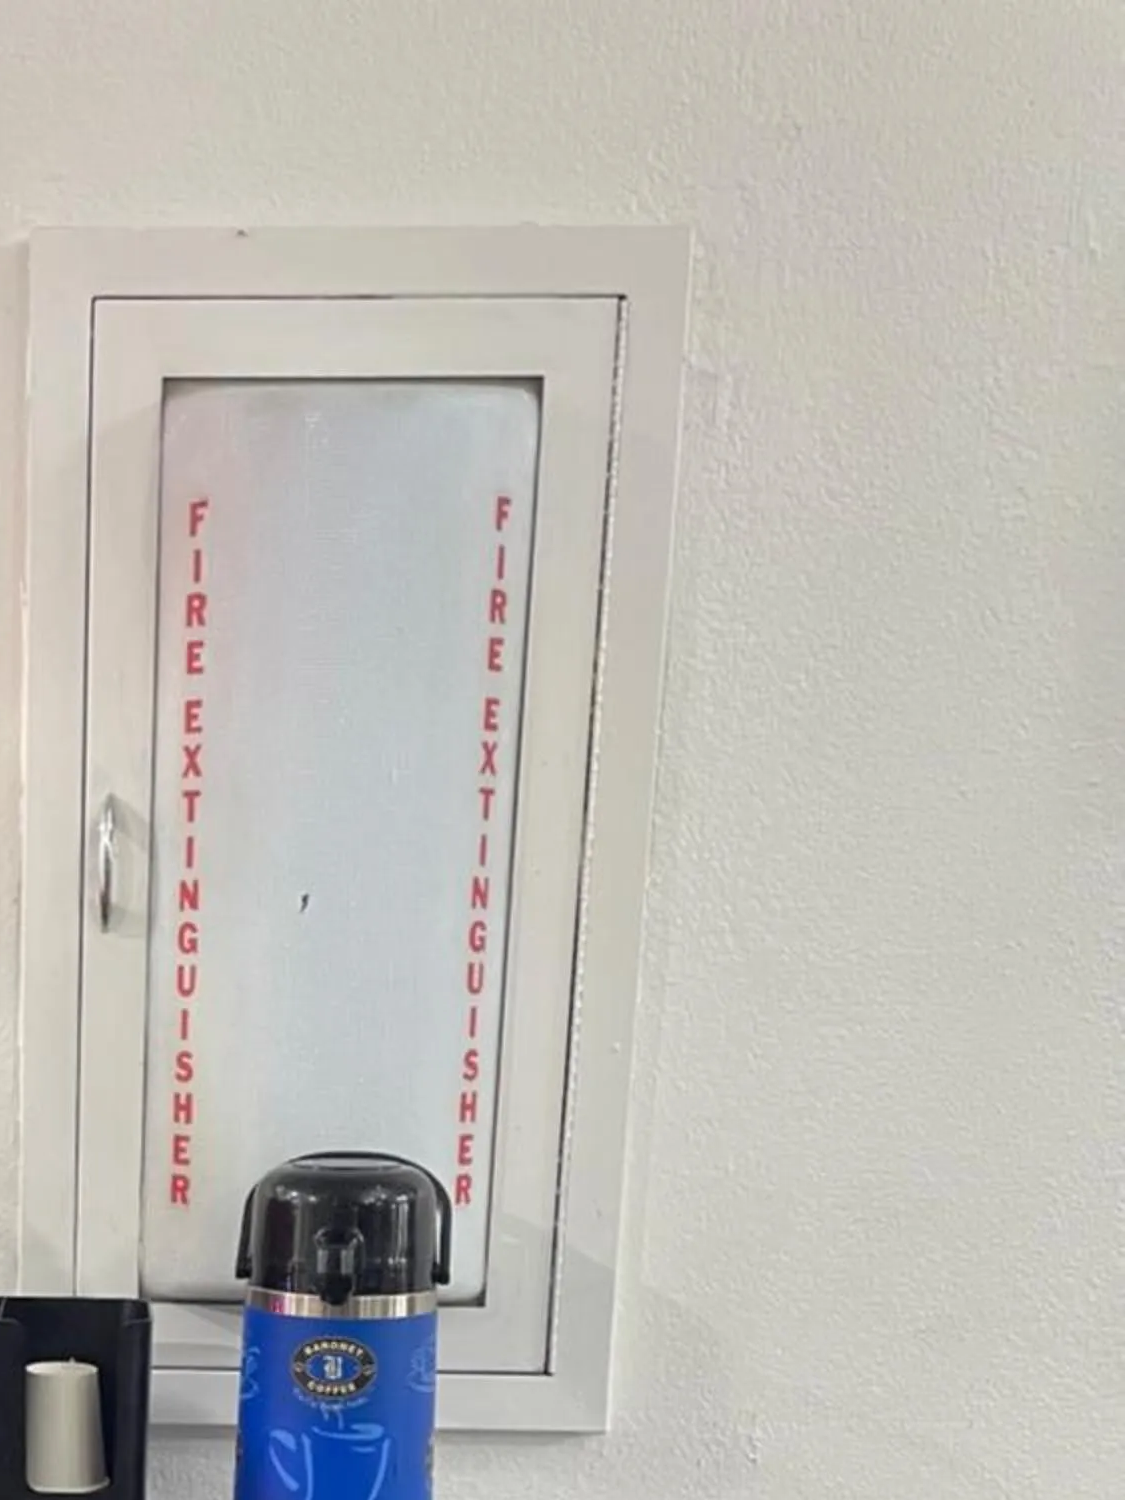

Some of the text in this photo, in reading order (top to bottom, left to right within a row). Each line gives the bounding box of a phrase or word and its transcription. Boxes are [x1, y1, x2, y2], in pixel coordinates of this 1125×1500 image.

[169, 499, 209, 1206] FIRE EXTINGUISHER
[453, 496, 510, 1206] FIRE EXTINGUISHER
[307, 1381, 356, 1394] COFFEE
